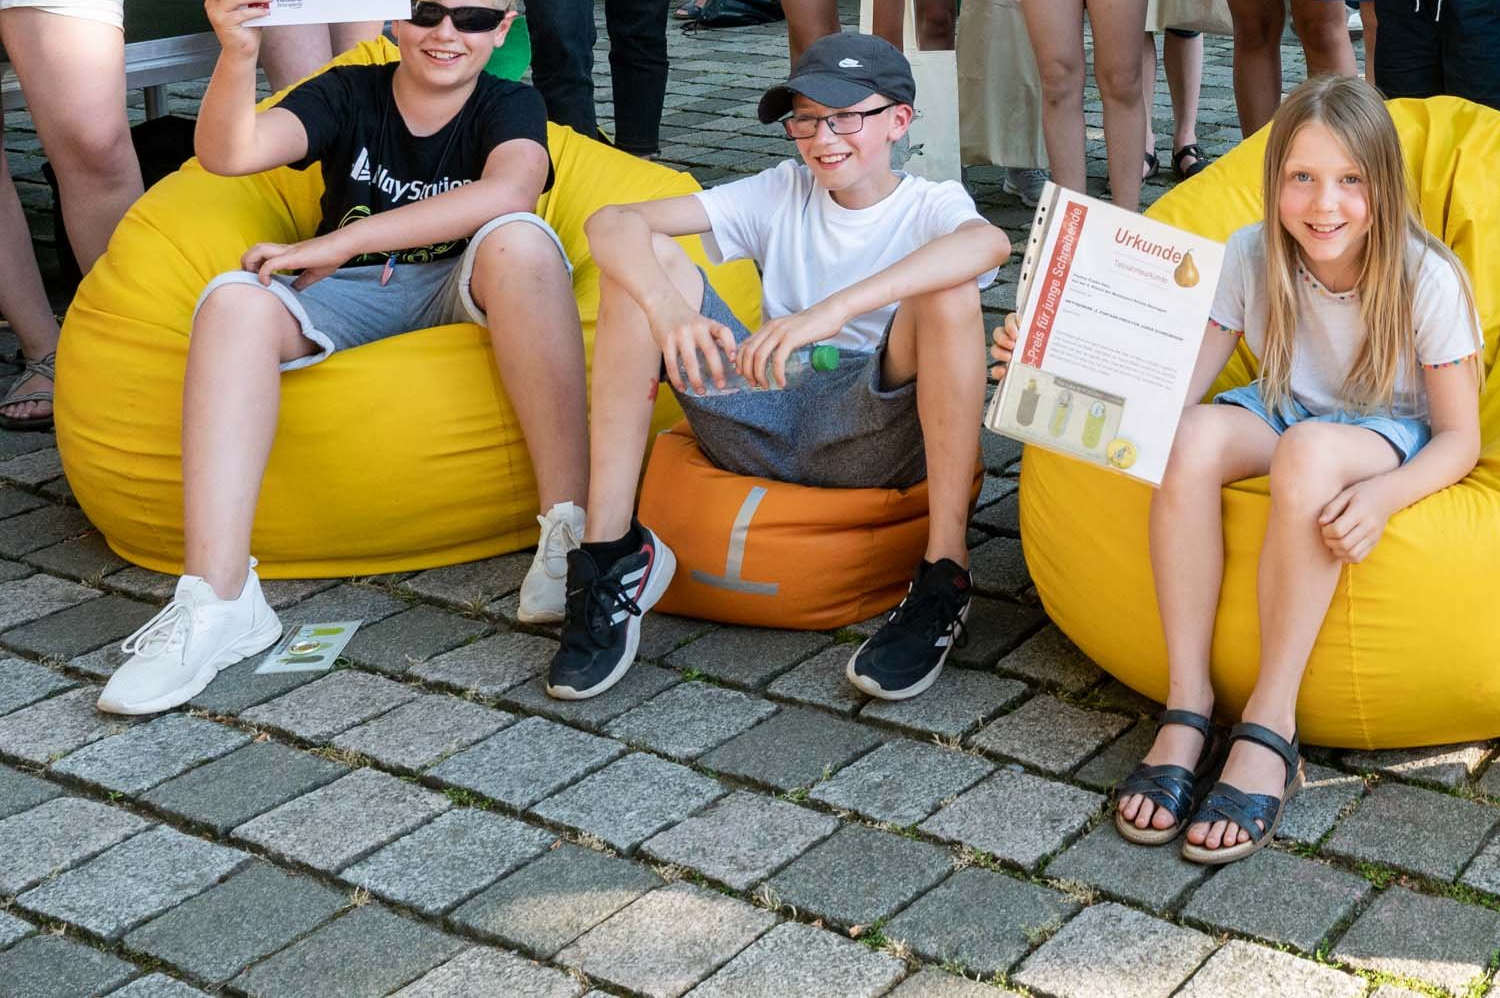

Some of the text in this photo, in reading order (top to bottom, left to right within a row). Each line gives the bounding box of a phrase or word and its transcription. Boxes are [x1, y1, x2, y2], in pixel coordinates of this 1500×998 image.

[1052, 208, 1082, 278] Schreibende
[1115, 227, 1182, 264] Urkunde
[1042, 278, 1061, 315] junge
[1036, 308, 1051, 330] für
